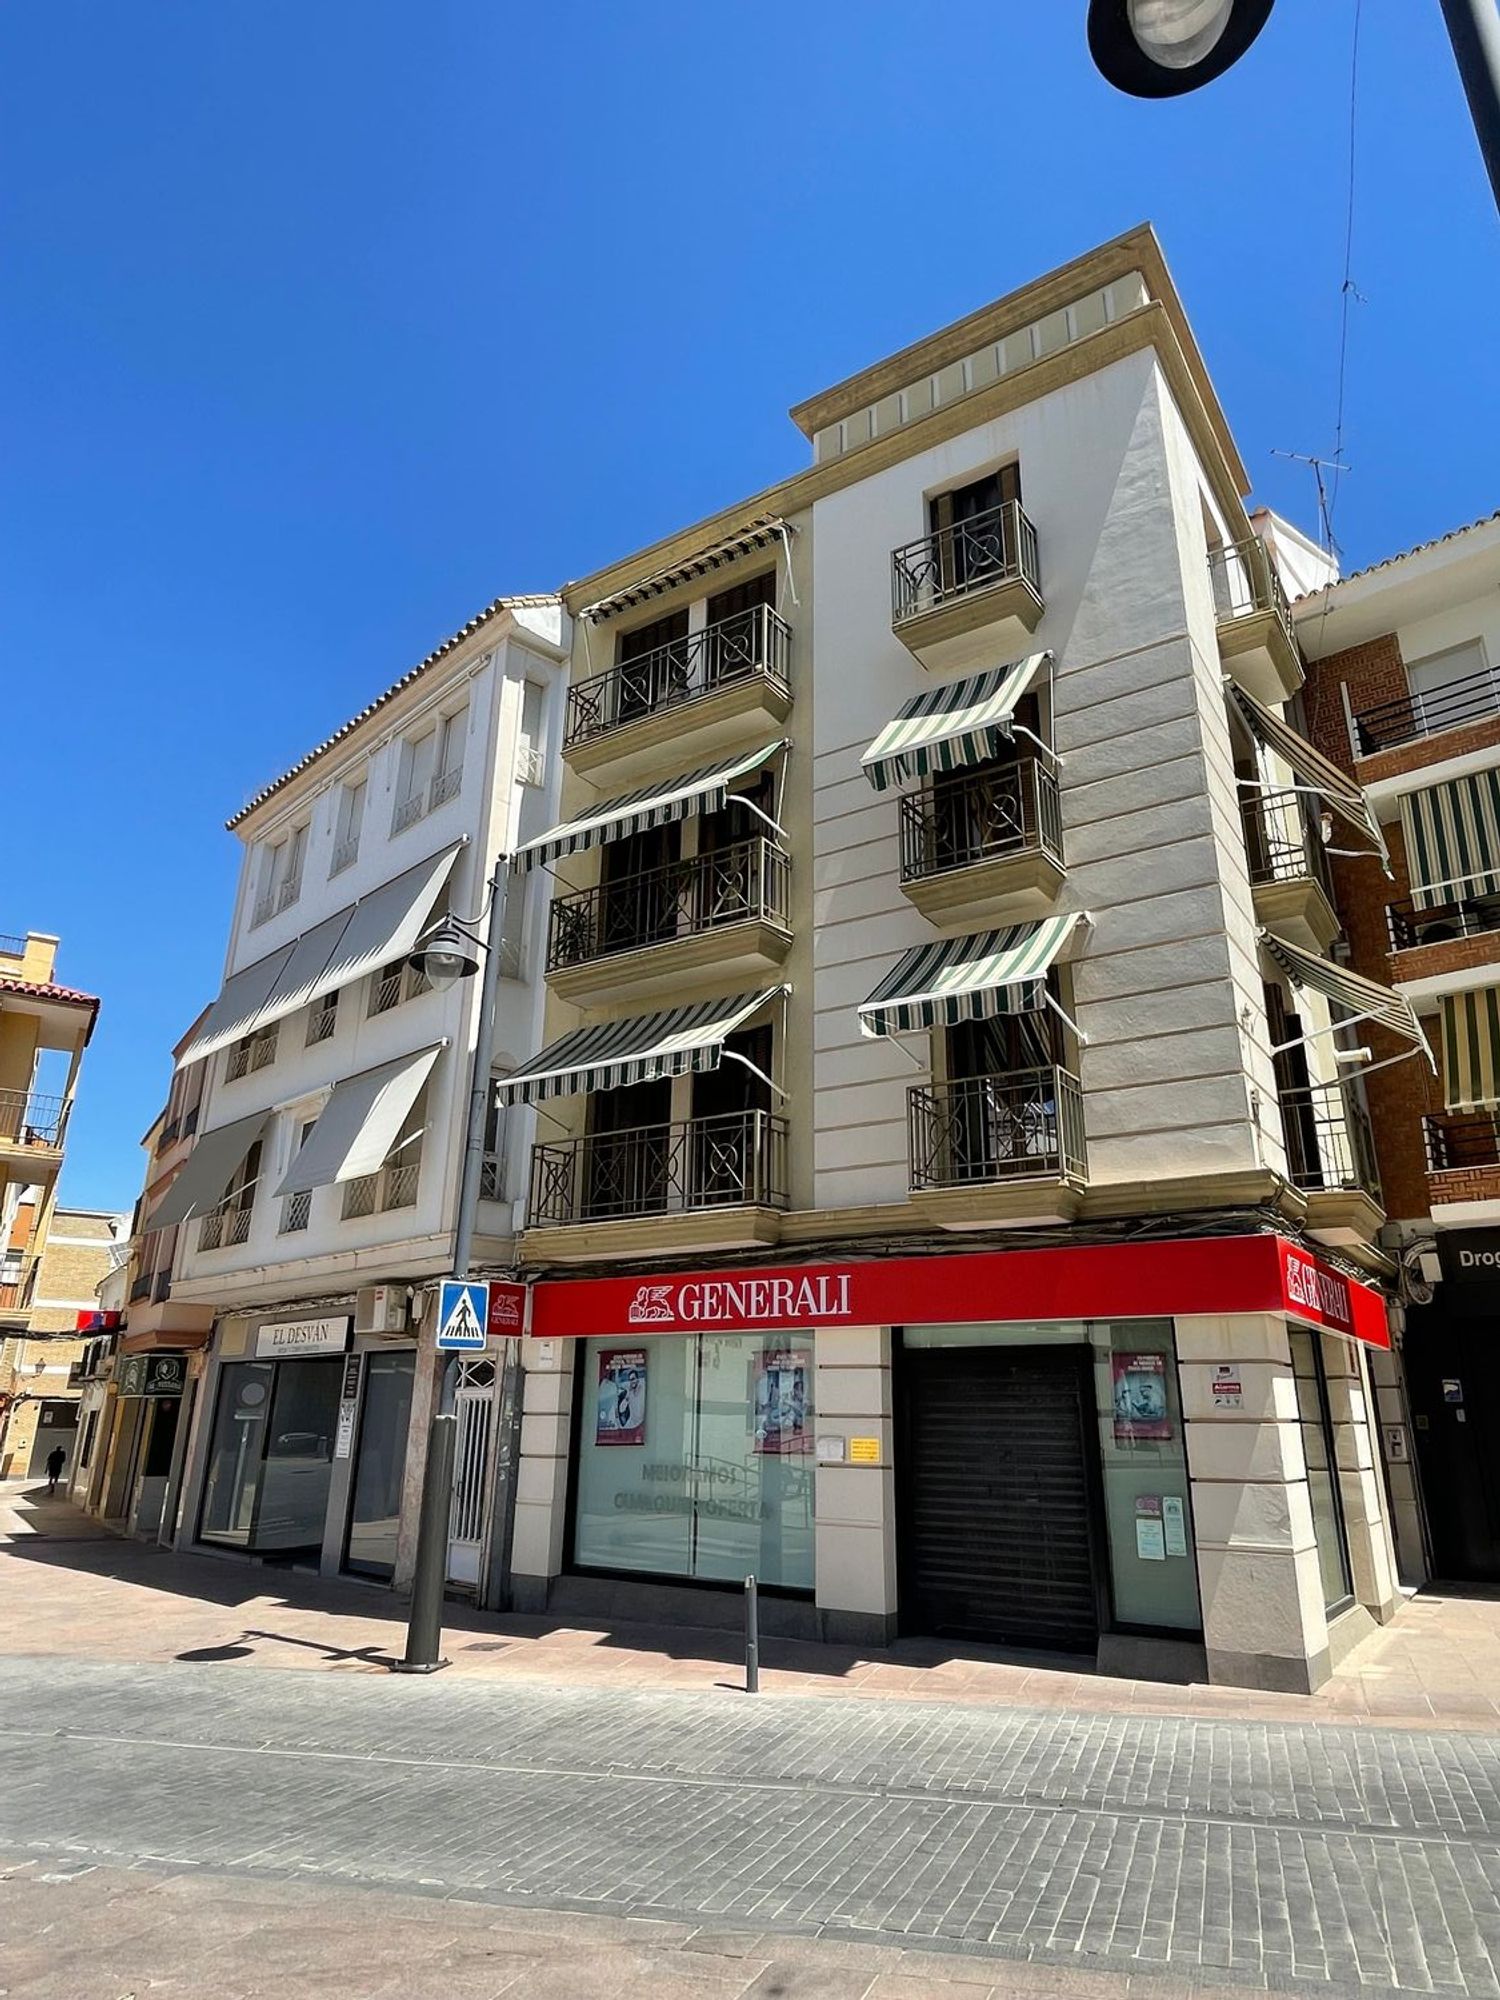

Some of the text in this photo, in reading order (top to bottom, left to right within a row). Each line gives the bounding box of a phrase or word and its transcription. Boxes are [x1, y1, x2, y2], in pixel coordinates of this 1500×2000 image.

[678, 1274, 852, 1321] GENERALI
[1302, 1262, 1350, 1324] GENERALI
[272, 1322, 329, 1346] EL DESVÁN
